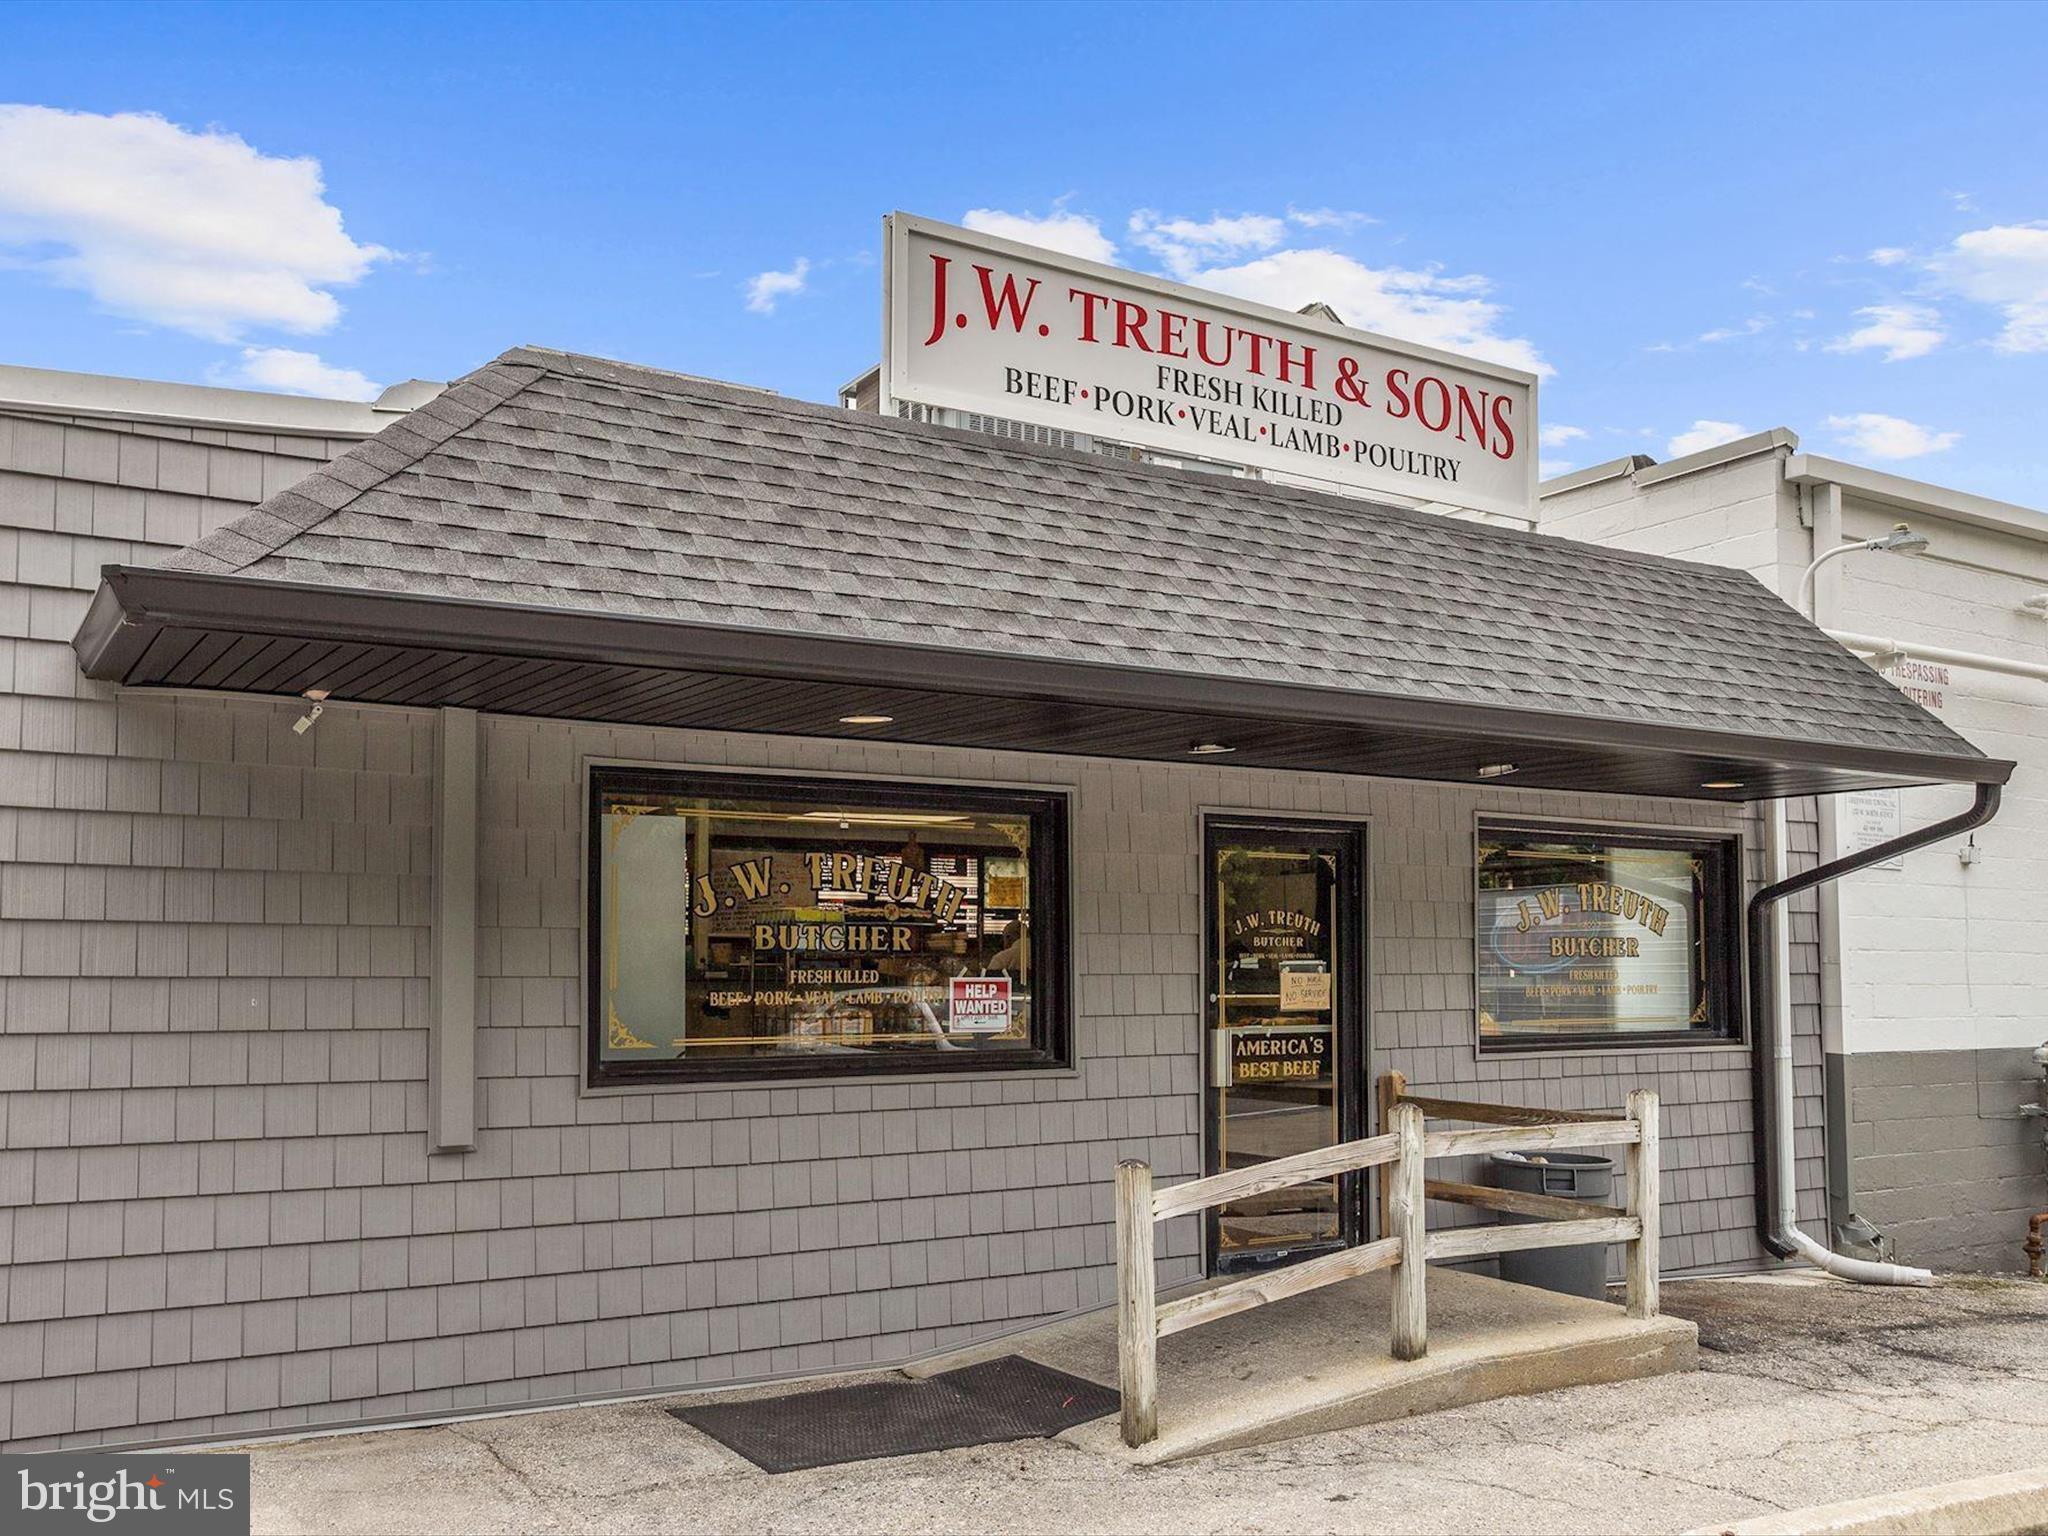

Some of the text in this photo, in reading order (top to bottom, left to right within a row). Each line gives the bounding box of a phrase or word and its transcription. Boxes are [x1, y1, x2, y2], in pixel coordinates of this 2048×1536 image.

[924, 254, 1516, 460] J.W. TREUTH & SONS
[1156, 364, 1343, 427] FRESH KILLED
[1004, 366, 1462, 483] BEEF PORK VEAL LAMB POULTRY
[693, 856, 791, 918] J.W.
[804, 851, 966, 924] TREUTH
[1516, 882, 1670, 937] J.W. TREUTH
[1235, 910, 1321, 937] J.W. TREUTH
[753, 924, 912, 952] BUTCHER
[1253, 936, 1304, 947] BUTCHER
[1550, 937, 1640, 958] BUTCHER
[789, 969, 880, 984] FRESH KILLED
[754, 991, 793, 1006] PORK
[965, 983, 998, 999] HELP
[955, 999, 1007, 1014] WANTED
[1236, 1036, 1325, 1056] AMERICA'S
[1239, 1060, 1321, 1078] BEST BEEF
